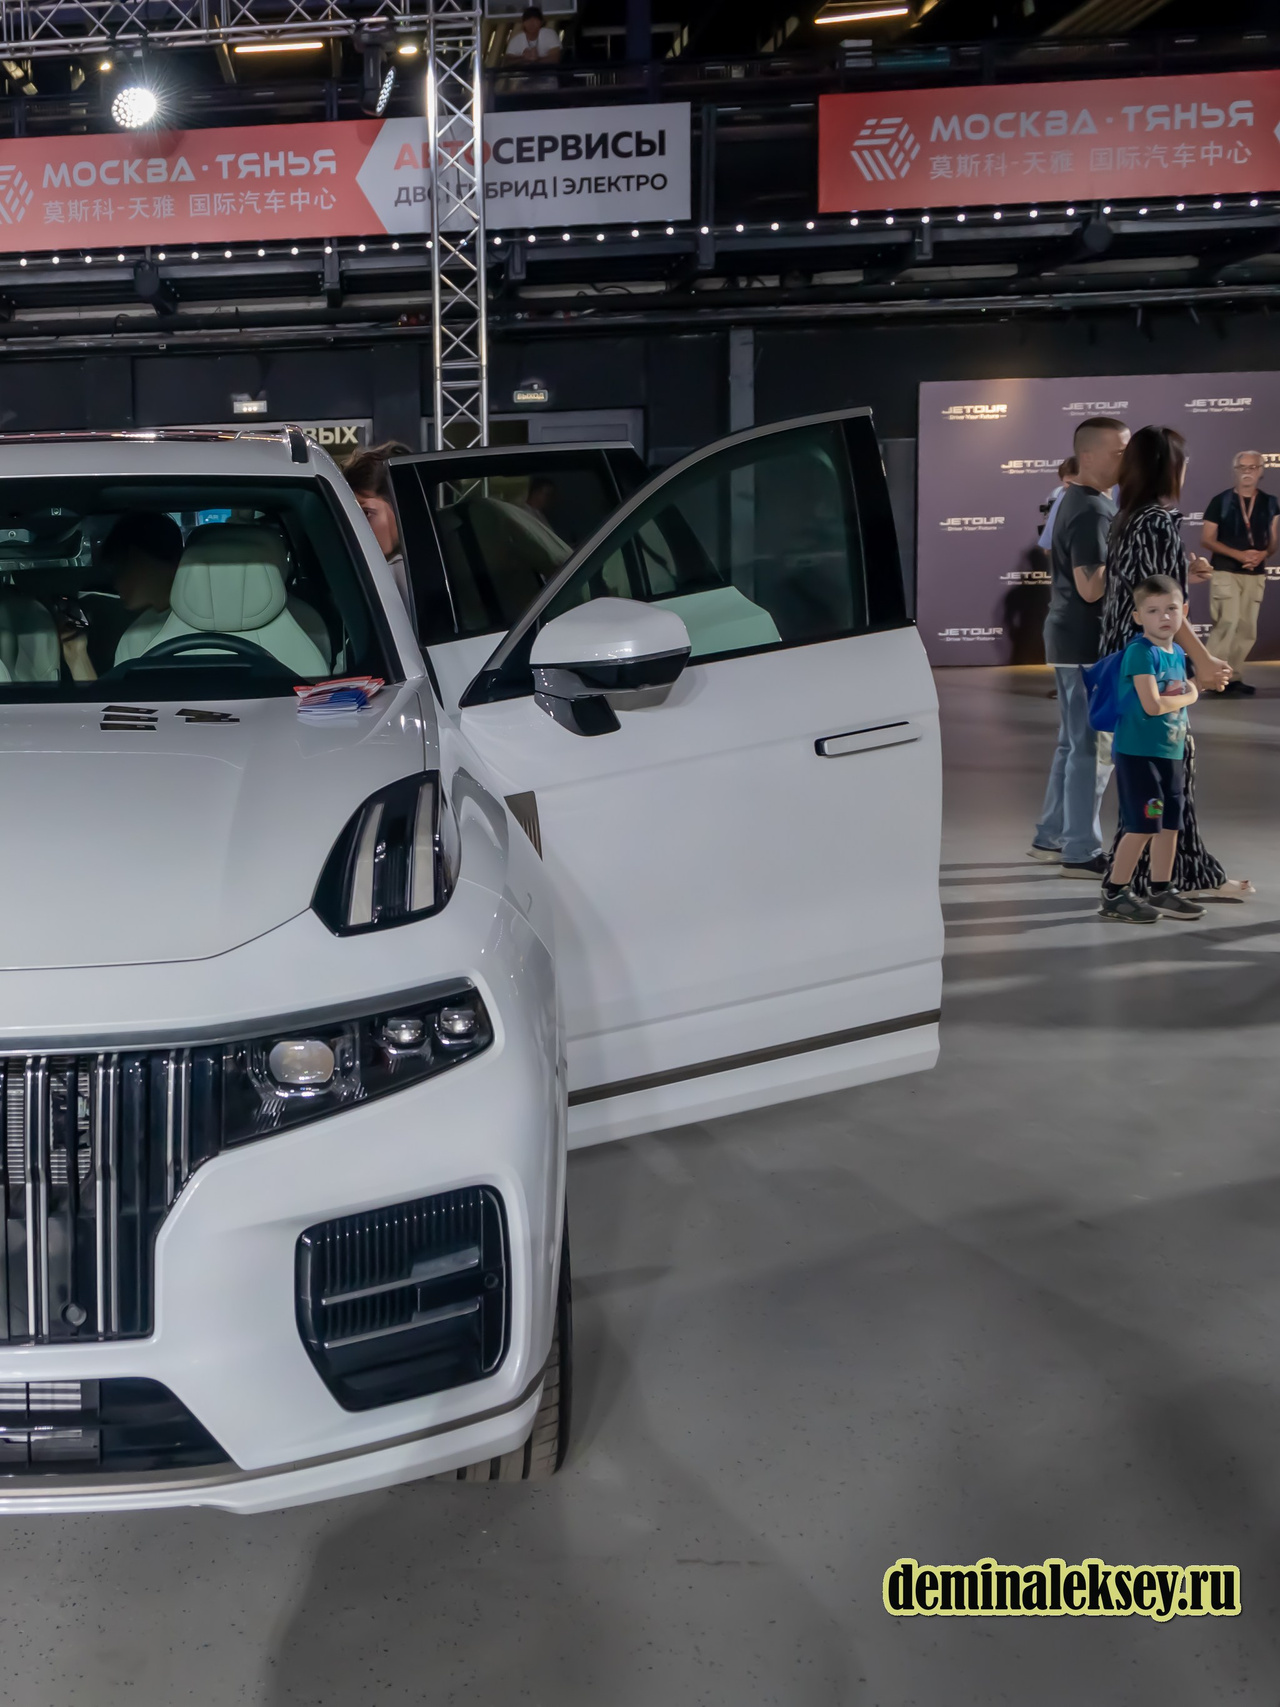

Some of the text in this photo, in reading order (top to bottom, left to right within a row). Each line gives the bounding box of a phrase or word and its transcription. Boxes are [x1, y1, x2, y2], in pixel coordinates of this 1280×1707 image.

[930, 100, 1255, 142] МОСКВА ТЯНЬЯ
[42, 148, 337, 189] МОСКВА ТЯНЬЯ
[929, 140, 1253, 181] 莫斯科-天雅 国际汽车中心
[562, 173, 668, 196] ЭЛЕКТРО
[43, 187, 337, 224] 莫斯科-天雅 国际汽车中心
[941, 404, 1008, 414] JETOUR
[1062, 401, 1129, 410] JETOUR
[1184, 398, 1252, 407] JETOUR
[939, 516, 1005, 526] JETOUR
[938, 627, 1003, 636] JETOUR
